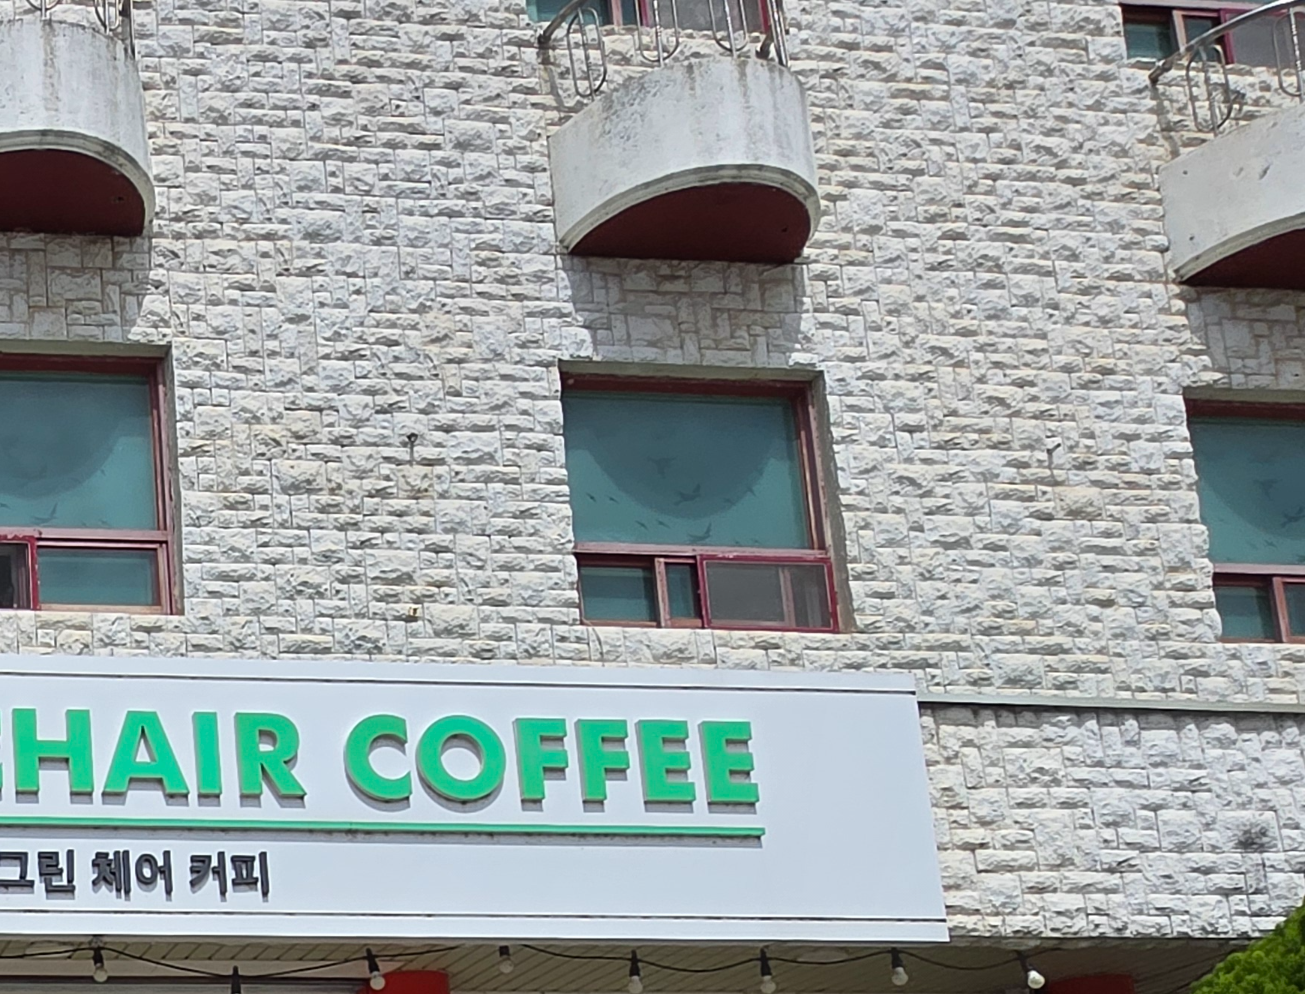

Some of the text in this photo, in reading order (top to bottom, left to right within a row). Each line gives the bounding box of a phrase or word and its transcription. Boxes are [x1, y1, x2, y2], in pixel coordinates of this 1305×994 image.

[343, 713, 759, 804] COFFEE
[91, 849, 173, 895] 체어
[189, 850, 270, 896] 커피
